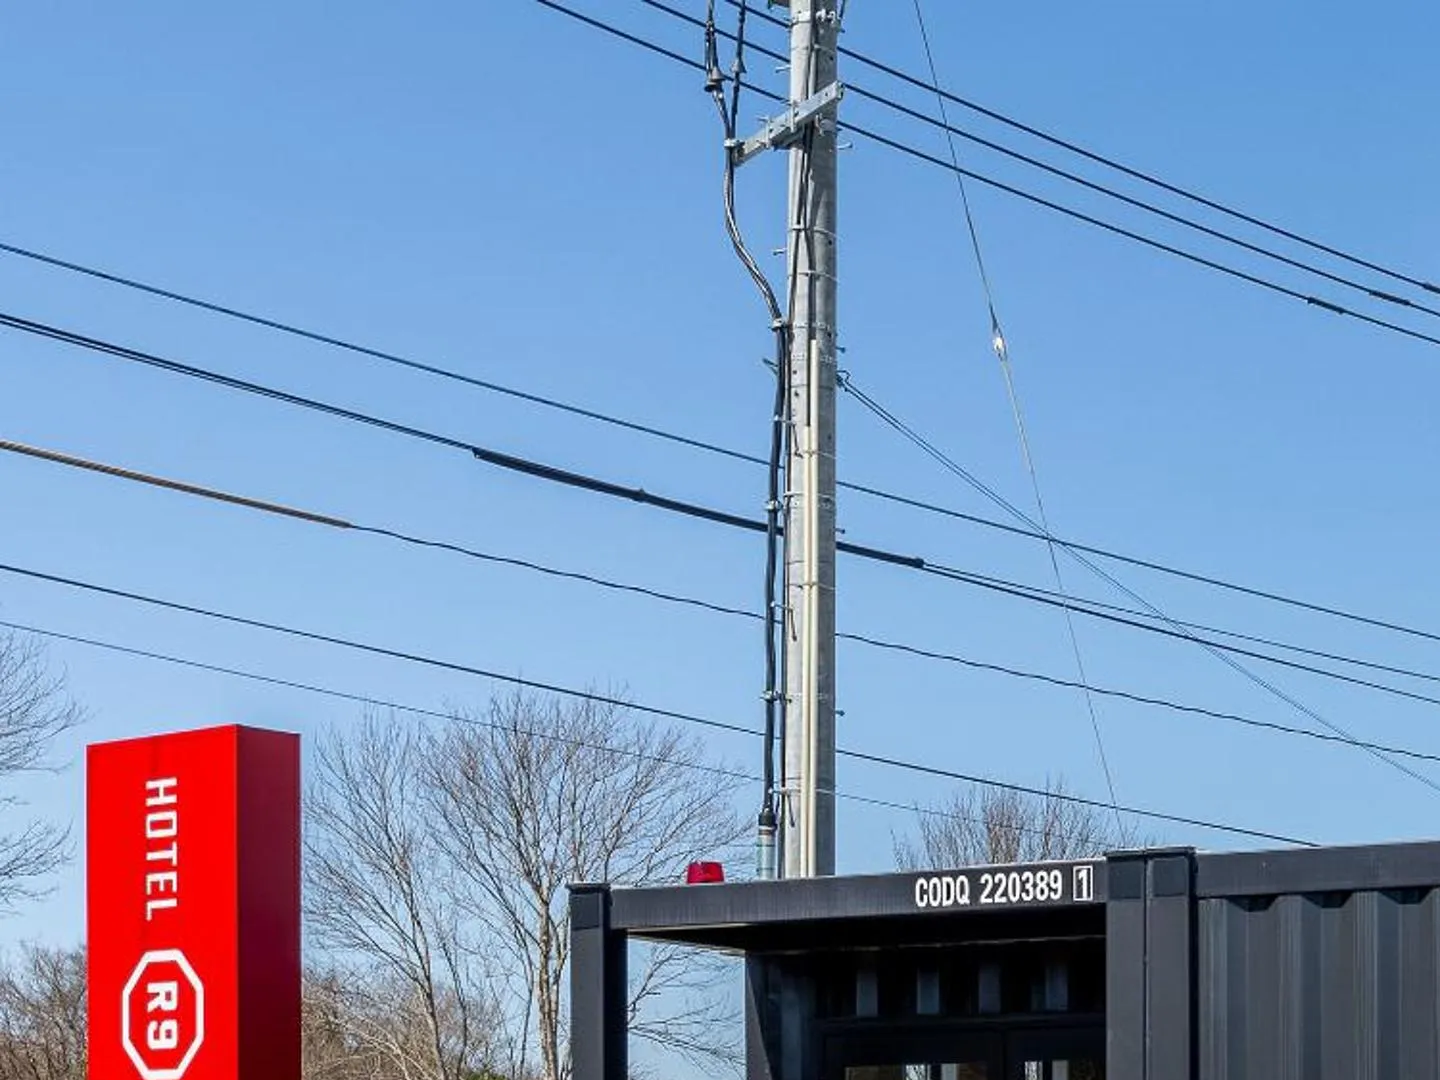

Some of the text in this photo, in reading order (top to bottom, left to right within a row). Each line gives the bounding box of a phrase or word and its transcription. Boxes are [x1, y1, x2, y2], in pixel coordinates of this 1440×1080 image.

[145, 777, 178, 921] HOTEL
[915, 874, 970, 908] CODQ
[979, 869, 1062, 904] 220389
[146, 980, 178, 1051] R9
